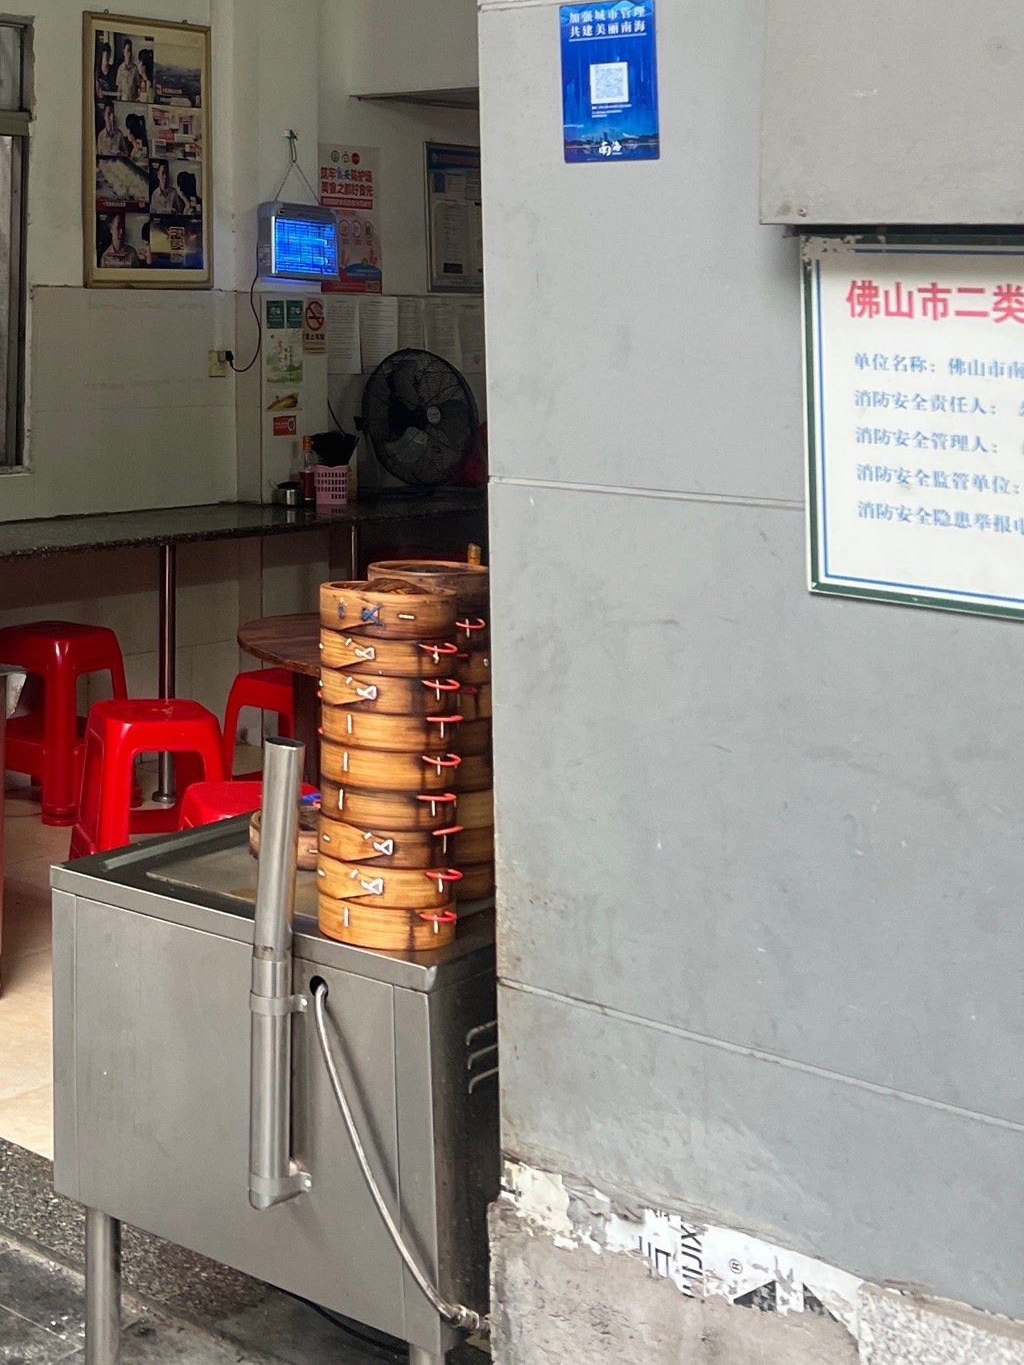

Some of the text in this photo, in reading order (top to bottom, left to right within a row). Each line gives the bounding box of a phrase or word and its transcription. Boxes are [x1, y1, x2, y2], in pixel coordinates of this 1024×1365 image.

[570, 20, 646, 37] 共建美丽南海
[846, 280, 1024, 324] 佛山市二类
